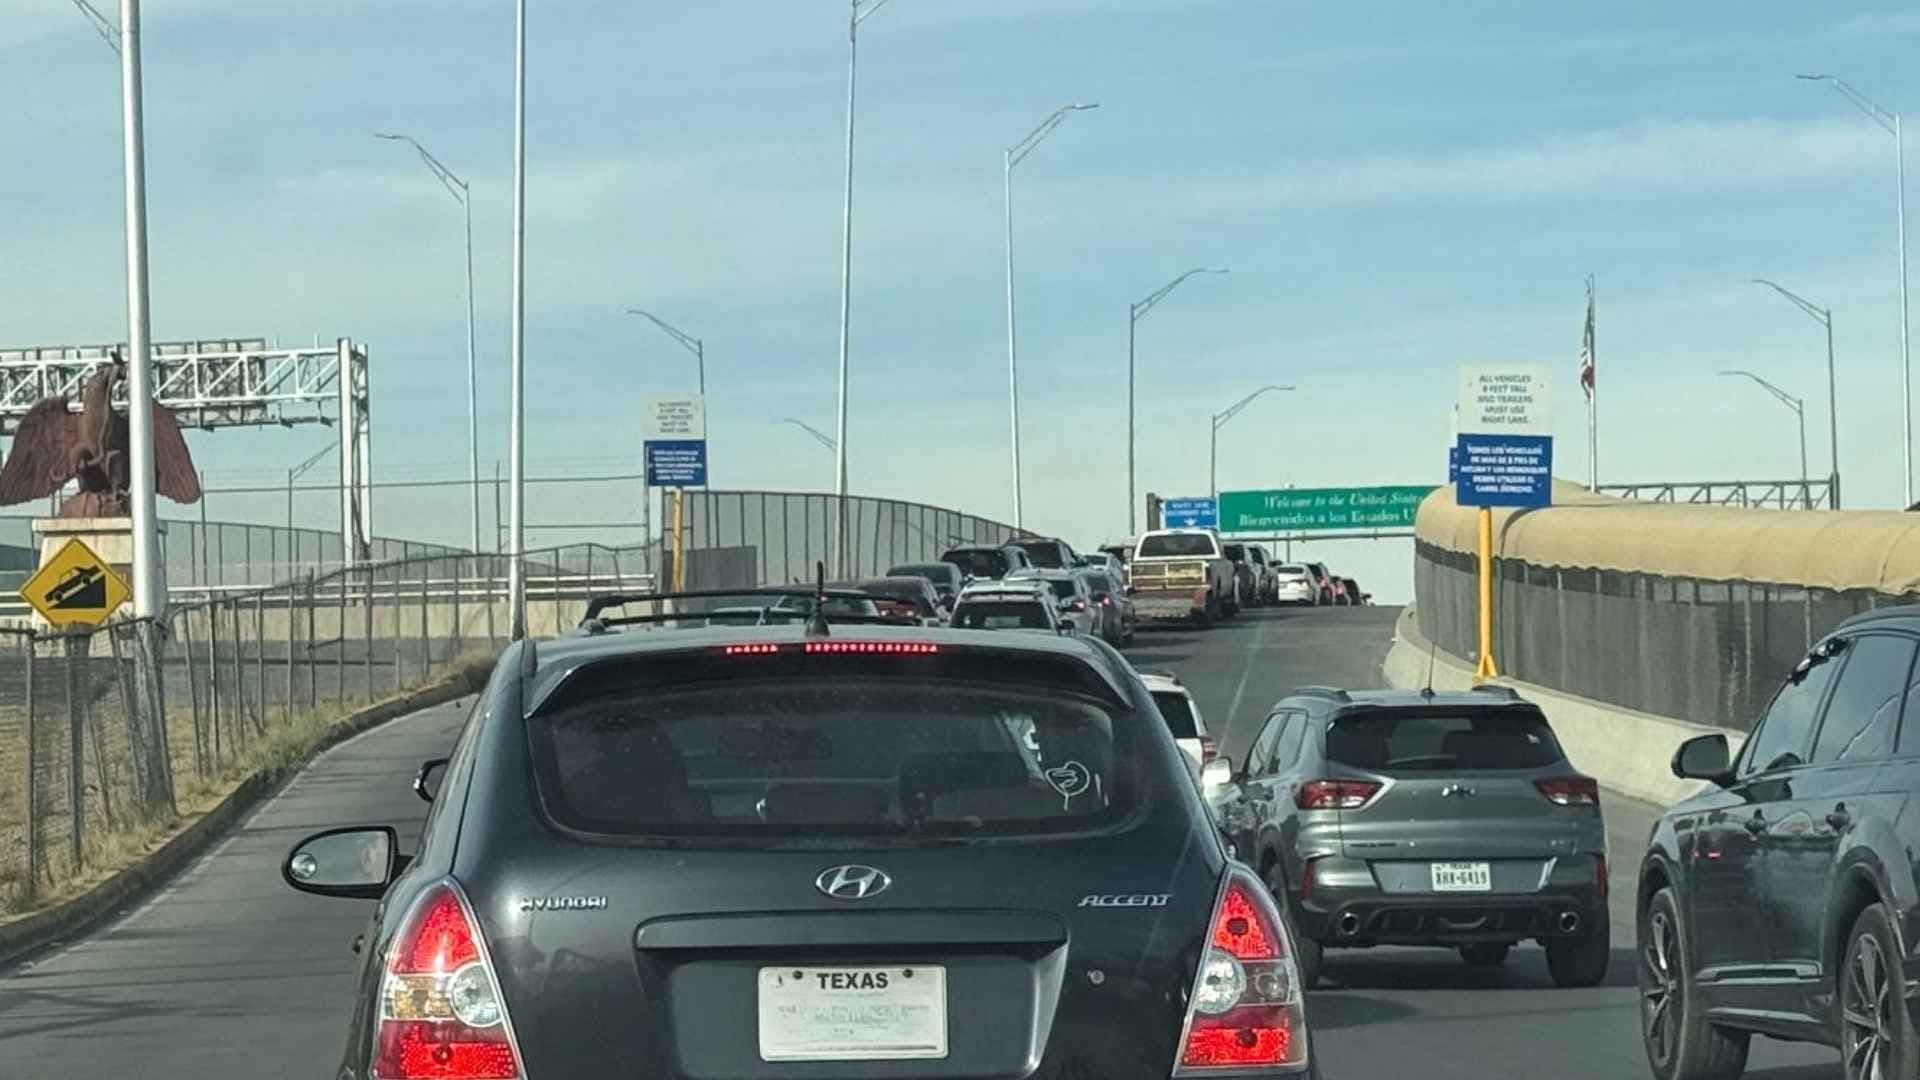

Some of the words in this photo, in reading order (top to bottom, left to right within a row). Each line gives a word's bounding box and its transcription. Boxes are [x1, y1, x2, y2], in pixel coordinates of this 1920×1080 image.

[1264, 496, 1312, 508] Welcome
[1314, 496, 1326, 507] to
[1328, 493, 1344, 505] the
[1350, 493, 1387, 505] United
[1239, 513, 1315, 527] Bienvenidos
[1317, 514, 1325, 523] a
[1328, 510, 1346, 523] los
[1077, 893, 1173, 907] ACCENT
[816, 972, 888, 989] TEXAS
